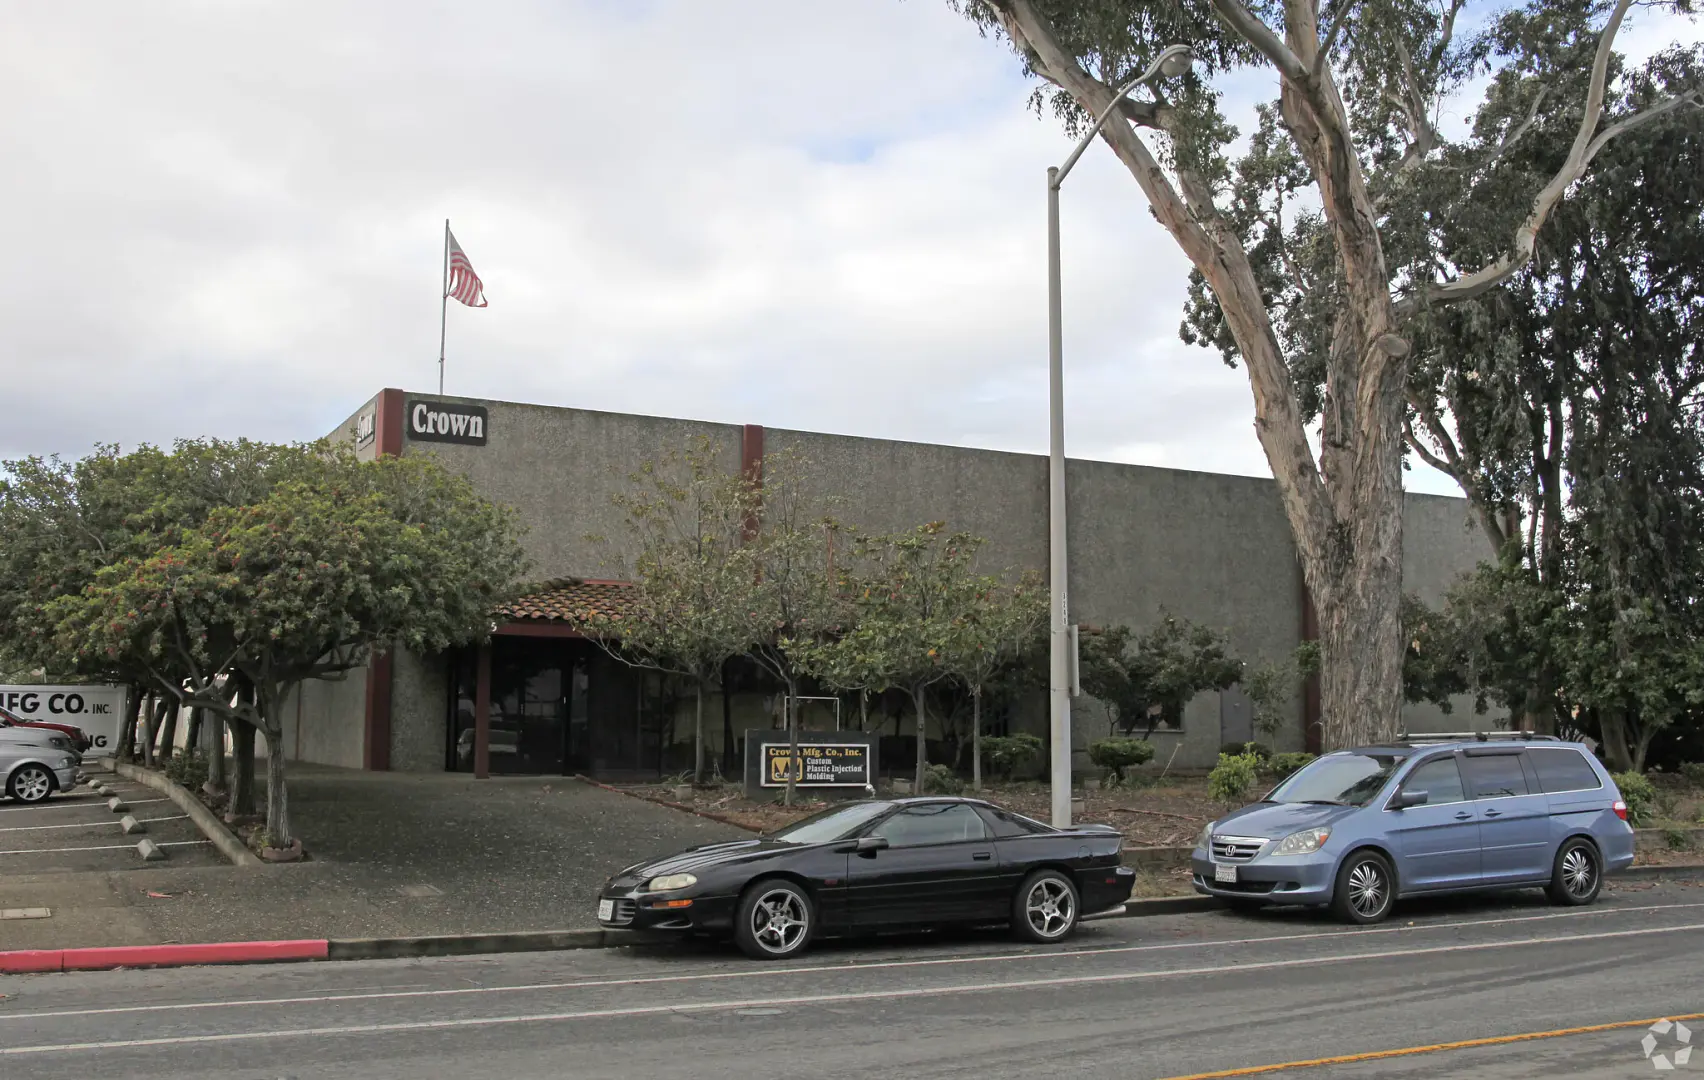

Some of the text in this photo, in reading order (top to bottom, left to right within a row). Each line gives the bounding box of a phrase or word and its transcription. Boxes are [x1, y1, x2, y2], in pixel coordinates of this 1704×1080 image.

[412, 403, 483, 438] Crown
[0, 693, 112, 714] FG CO. INC.
[803, 748, 823, 758] Mfg.
[825, 748, 842, 757] Co.,
[845, 748, 862, 756] Inc.
[806, 757, 832, 765] Custom
[831, 765, 863, 774] Injection
[806, 773, 835, 781] Molding
